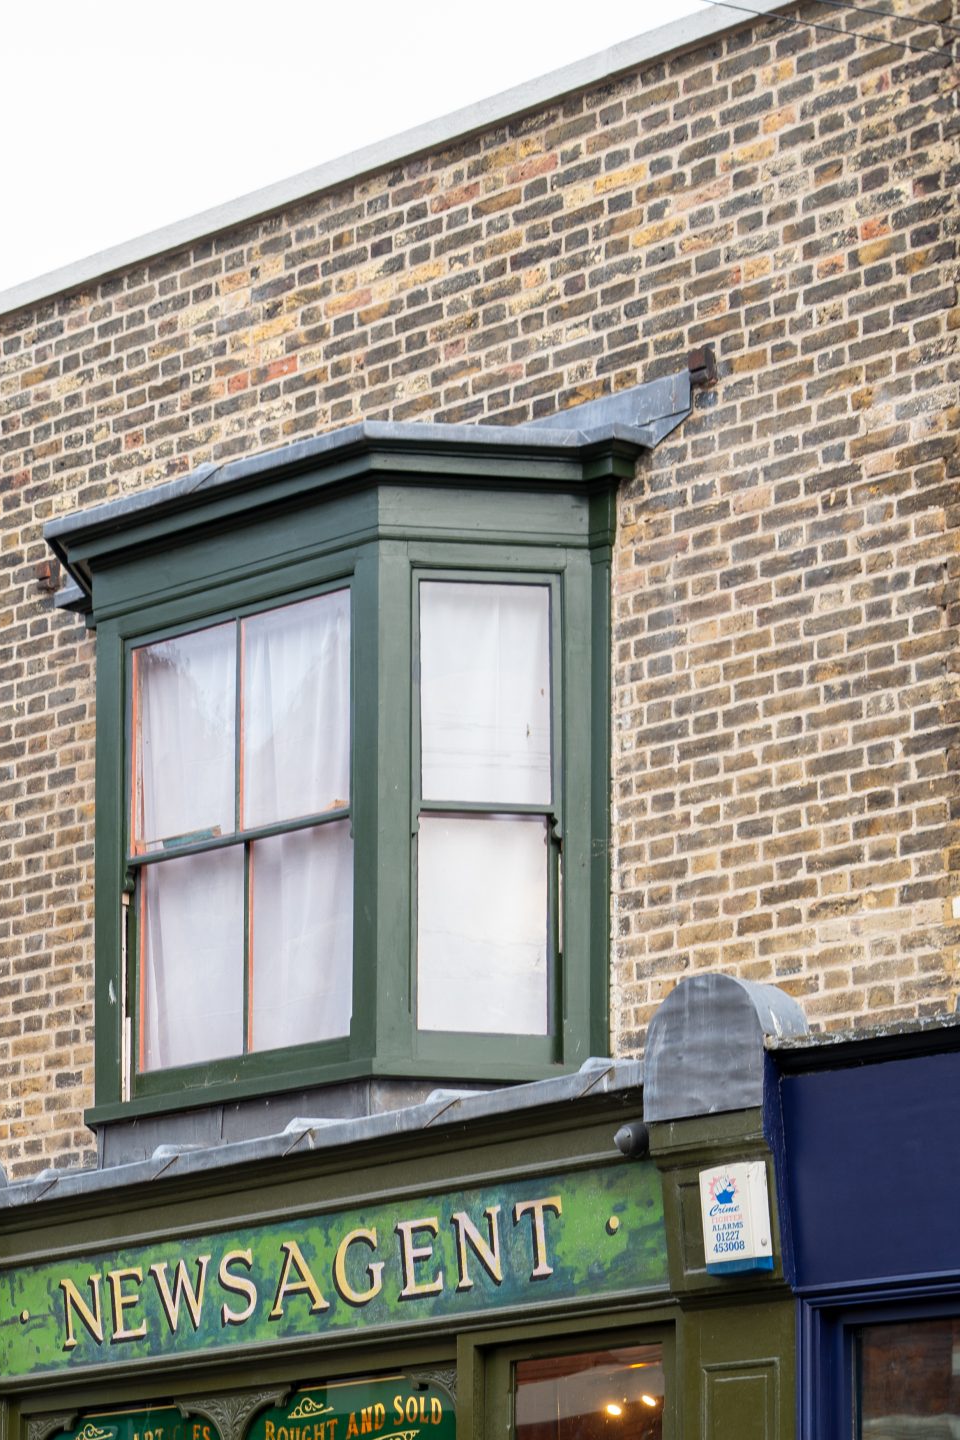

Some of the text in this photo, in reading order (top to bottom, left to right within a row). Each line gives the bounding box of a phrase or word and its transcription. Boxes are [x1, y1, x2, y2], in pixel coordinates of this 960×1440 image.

[709, 1204, 740, 1216] Crime
[712, 1221, 744, 1231] ALARMS
[716, 1230, 739, 1242] 01227
[713, 1240, 745, 1253] 453008
[60, 1196, 563, 1349] NEWSAGENT
[345, 1402, 386, 1440] AND
[392, 1394, 442, 1426] SOLD
